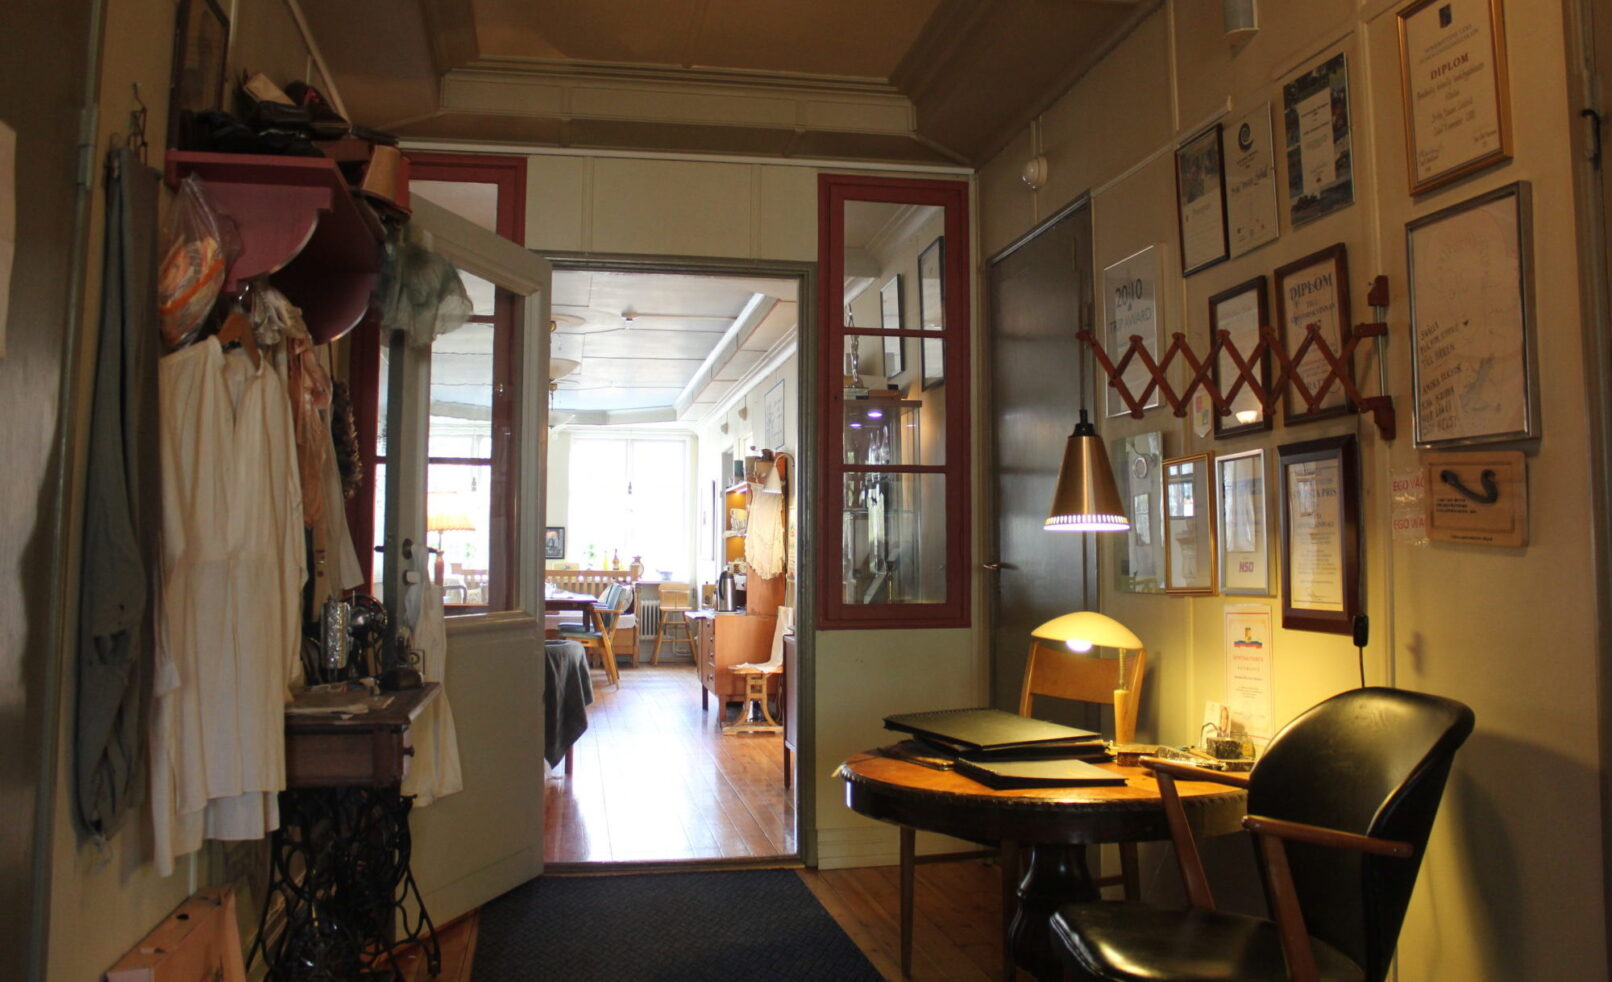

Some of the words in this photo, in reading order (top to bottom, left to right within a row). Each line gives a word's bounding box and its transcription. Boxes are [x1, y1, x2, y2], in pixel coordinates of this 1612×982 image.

[1430, 53, 1469, 80] DIPLOM
[1115, 278, 1143, 308] 2010
[1289, 273, 1333, 301] DIPLOM
[1393, 480, 1408, 492] EGO
[1393, 519, 1409, 529] EGO
[1410, 518, 1424, 528] WA
